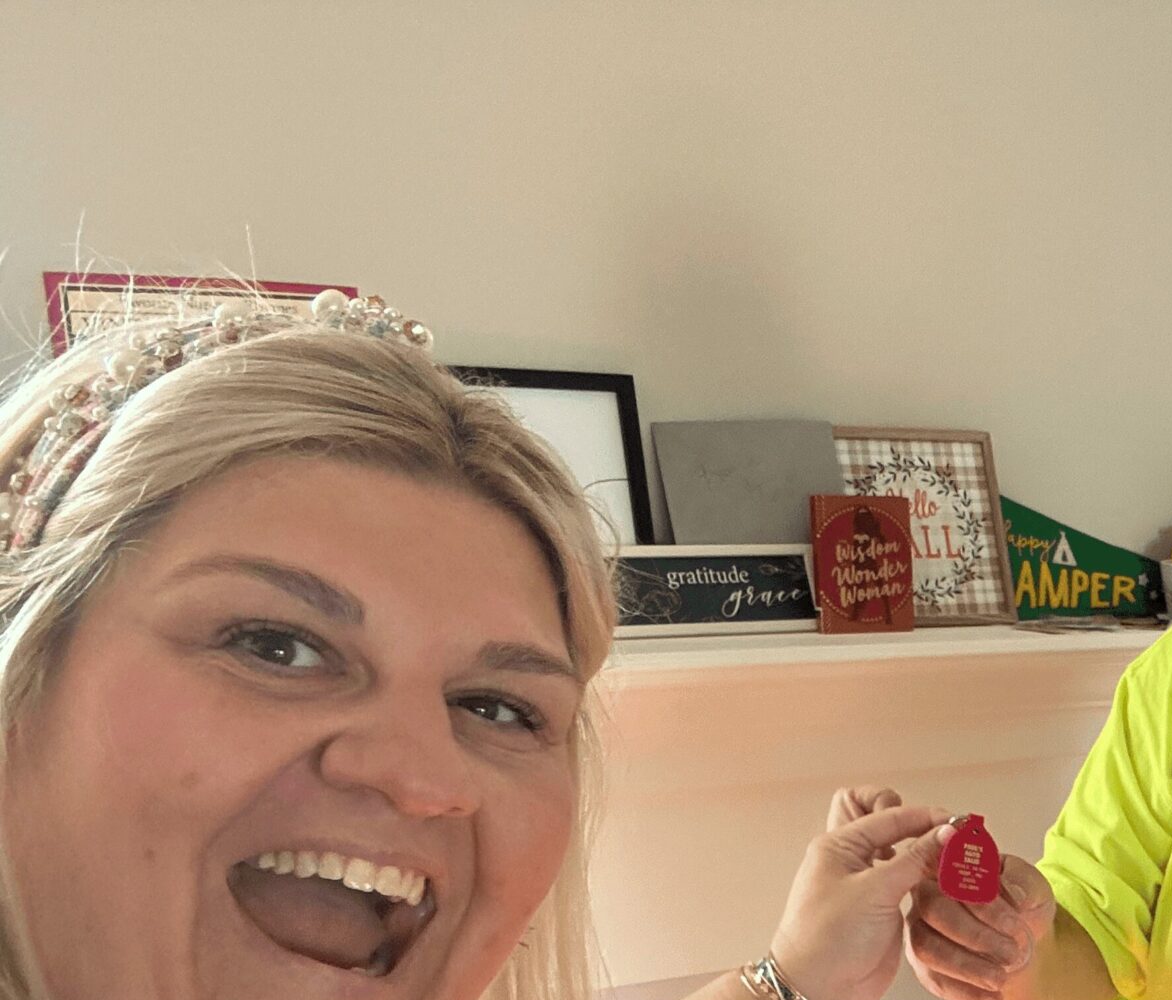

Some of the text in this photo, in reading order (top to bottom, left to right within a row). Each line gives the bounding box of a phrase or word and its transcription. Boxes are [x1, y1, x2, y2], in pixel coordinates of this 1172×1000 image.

[836, 537, 900, 563] Wisdom
[667, 565, 750, 590] gratitude
[831, 558, 908, 586] Wonder
[1015, 559, 1137, 609] AMPER
[721, 586, 804, 618] grace
[839, 580, 905, 608] Woman
